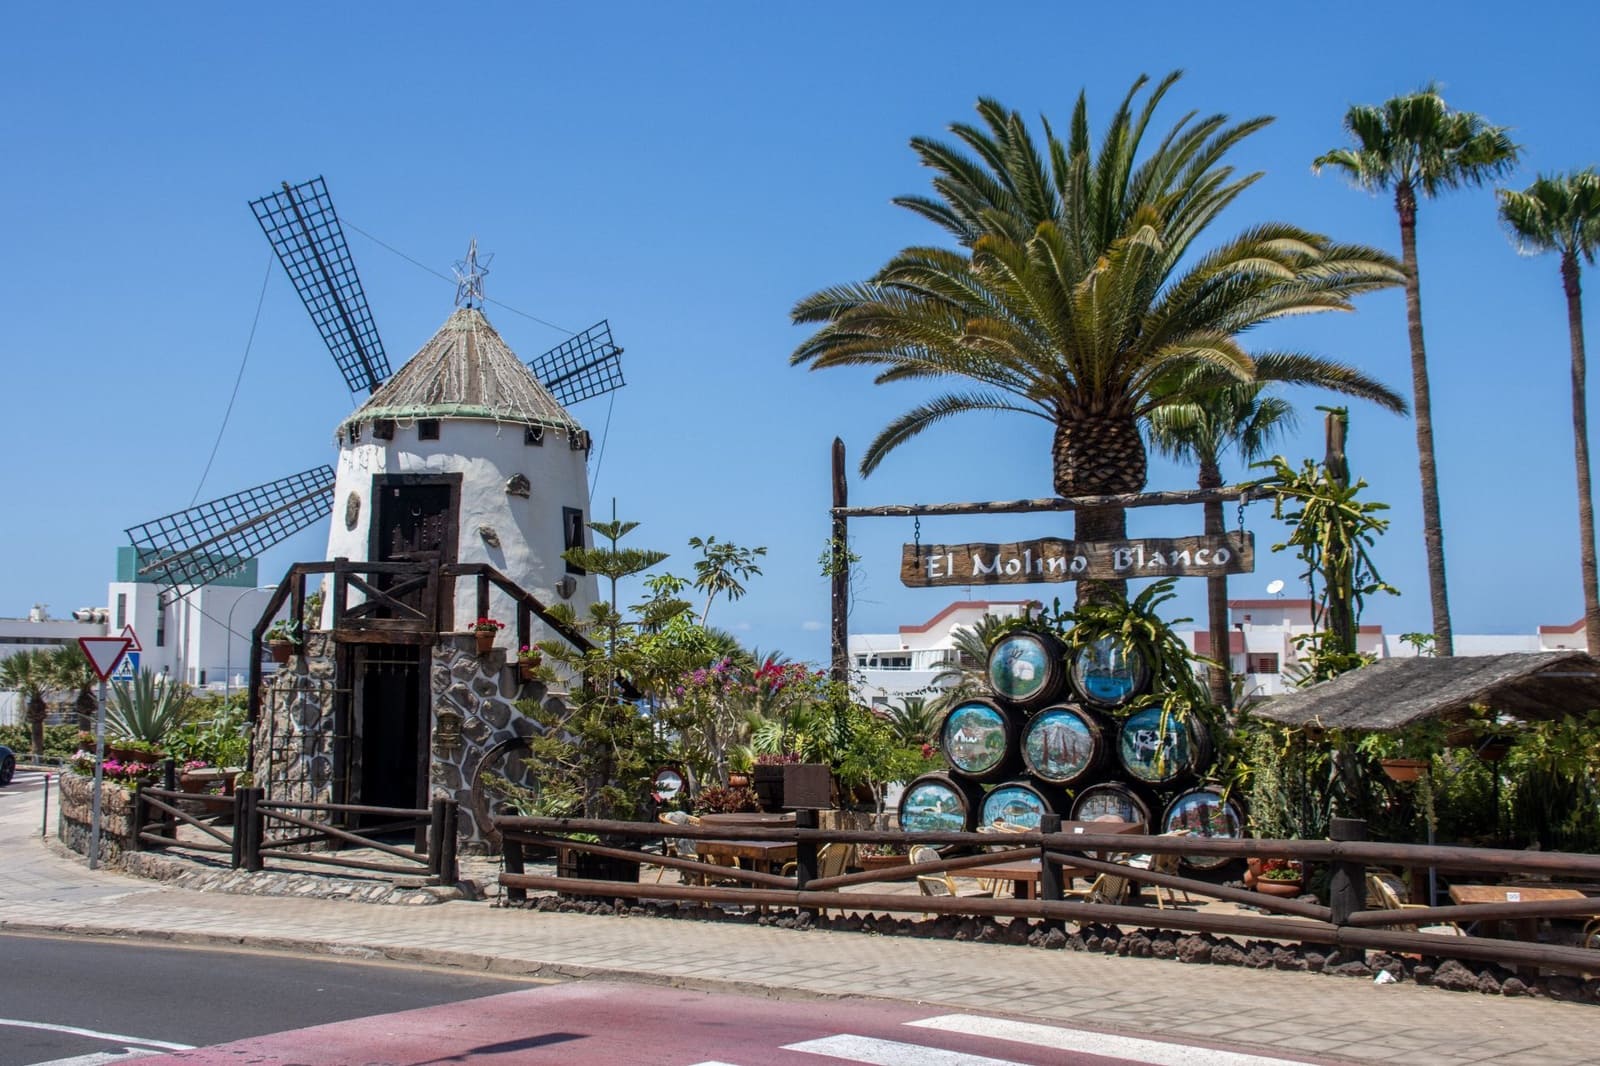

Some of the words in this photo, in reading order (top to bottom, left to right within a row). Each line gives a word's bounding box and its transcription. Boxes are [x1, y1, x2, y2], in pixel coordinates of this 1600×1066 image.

[926, 552, 954, 578] El
[973, 549, 1088, 575] Molino
[1114, 544, 1231, 570] Blanco
